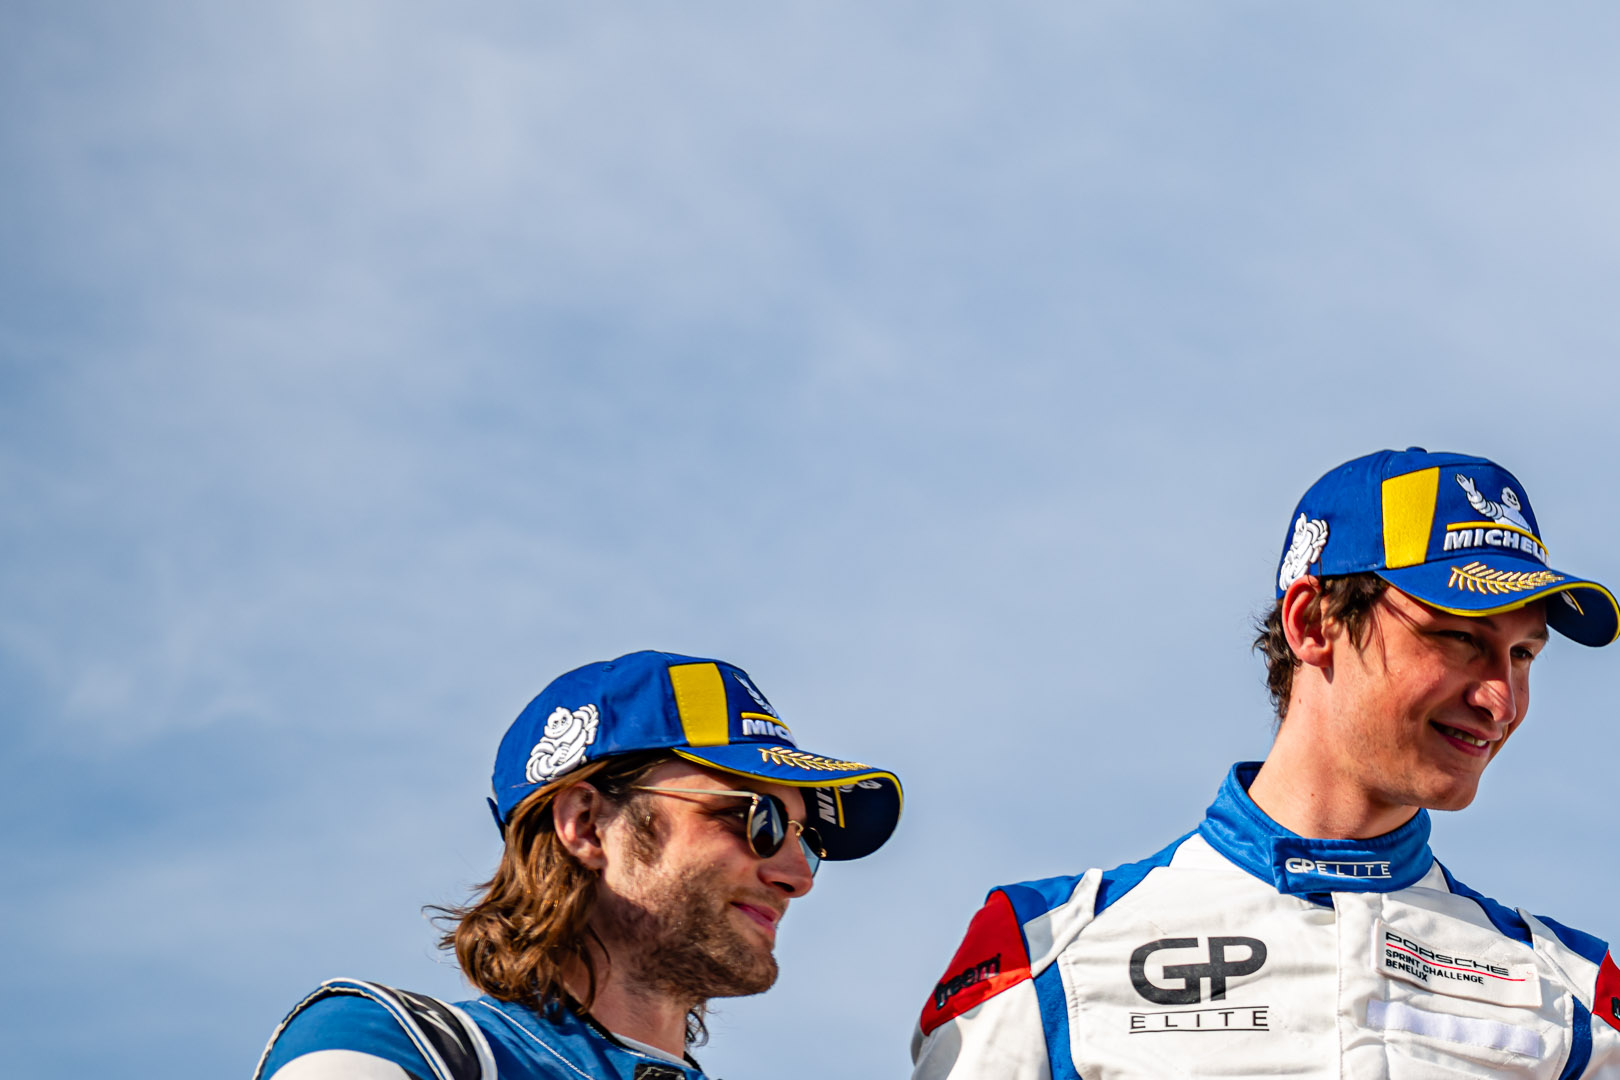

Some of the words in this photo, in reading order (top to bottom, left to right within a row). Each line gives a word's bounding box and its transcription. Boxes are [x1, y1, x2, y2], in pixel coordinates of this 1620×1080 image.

[1285, 858, 1316, 873] GP
[1316, 863, 1391, 877] ELITE
[1385, 931, 1509, 977] PORSCHE
[1386, 949, 1420, 969] SPRINT
[1422, 964, 1484, 985] CHALLENGE
[1129, 936, 1268, 1006] GP
[1386, 958, 1428, 983] BENELUX
[1130, 1010, 1268, 1030] ELITE
